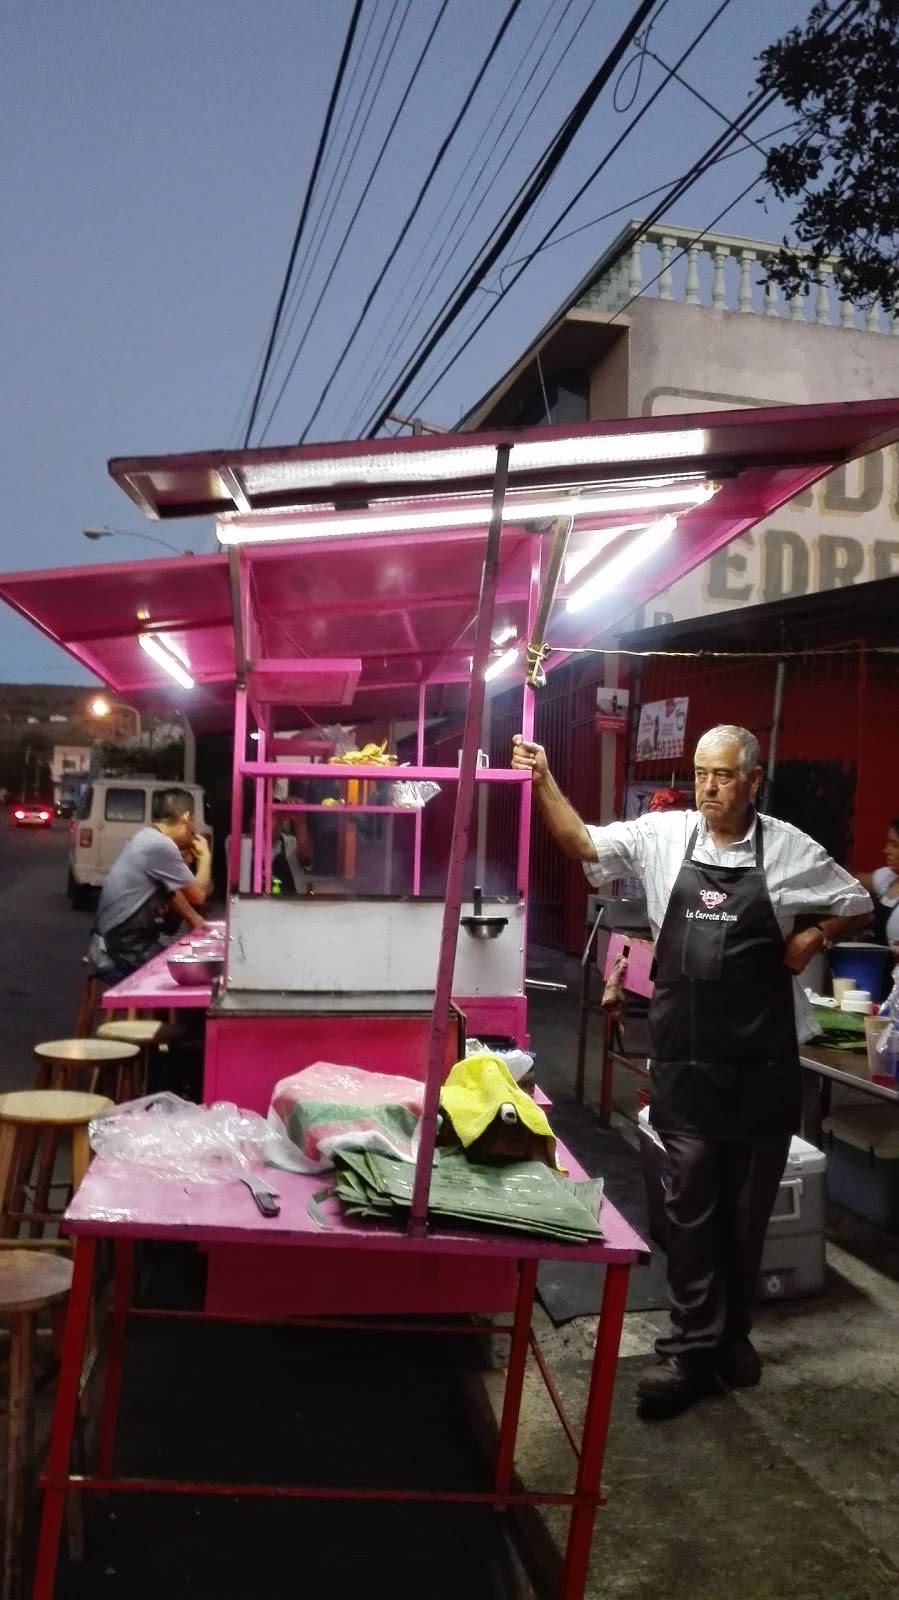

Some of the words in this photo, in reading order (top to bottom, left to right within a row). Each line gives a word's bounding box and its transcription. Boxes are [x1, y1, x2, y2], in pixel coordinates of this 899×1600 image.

[686, 909, 694, 918] La
[695, 910, 720, 920] Carreta
[721, 912, 738, 921] Rosa
